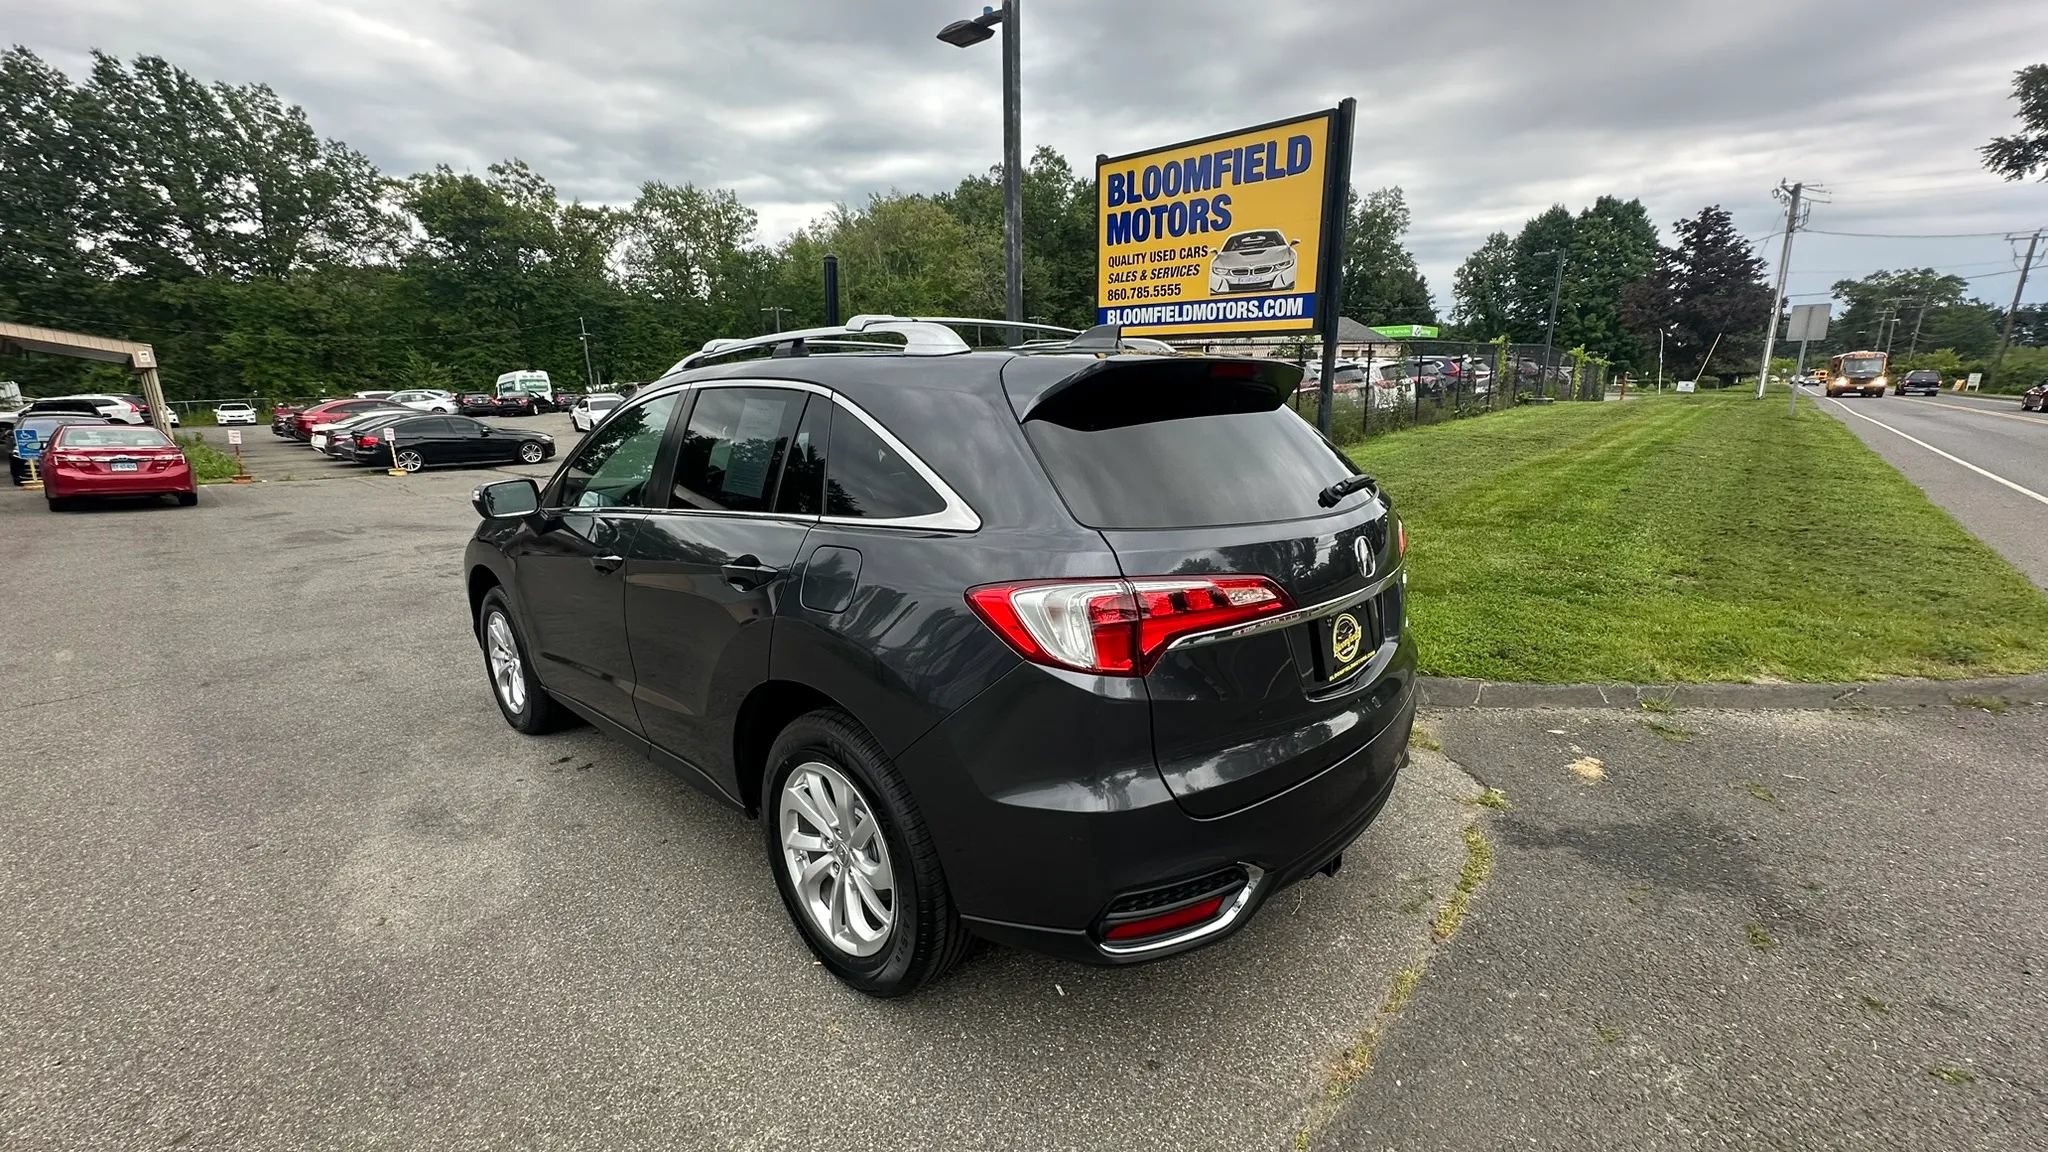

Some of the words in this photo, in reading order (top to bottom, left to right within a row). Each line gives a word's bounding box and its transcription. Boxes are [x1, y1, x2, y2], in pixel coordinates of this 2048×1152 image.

[1108, 135, 1311, 207] BLOOMFIELD
[1107, 194, 1232, 245] MOTORS
[1108, 252, 1147, 268] QUALITY
[1150, 249, 1176, 263] USED
[1180, 245, 1208, 259] CARS
[1108, 271, 1137, 284] SALES
[1140, 270, 1147, 280] &
[1150, 264, 1200, 280] SERVICES
[1107, 283, 1181, 301] 860.785.5555
[1107, 297, 1303, 325] BLOOMFIELDMOTORS.COM
